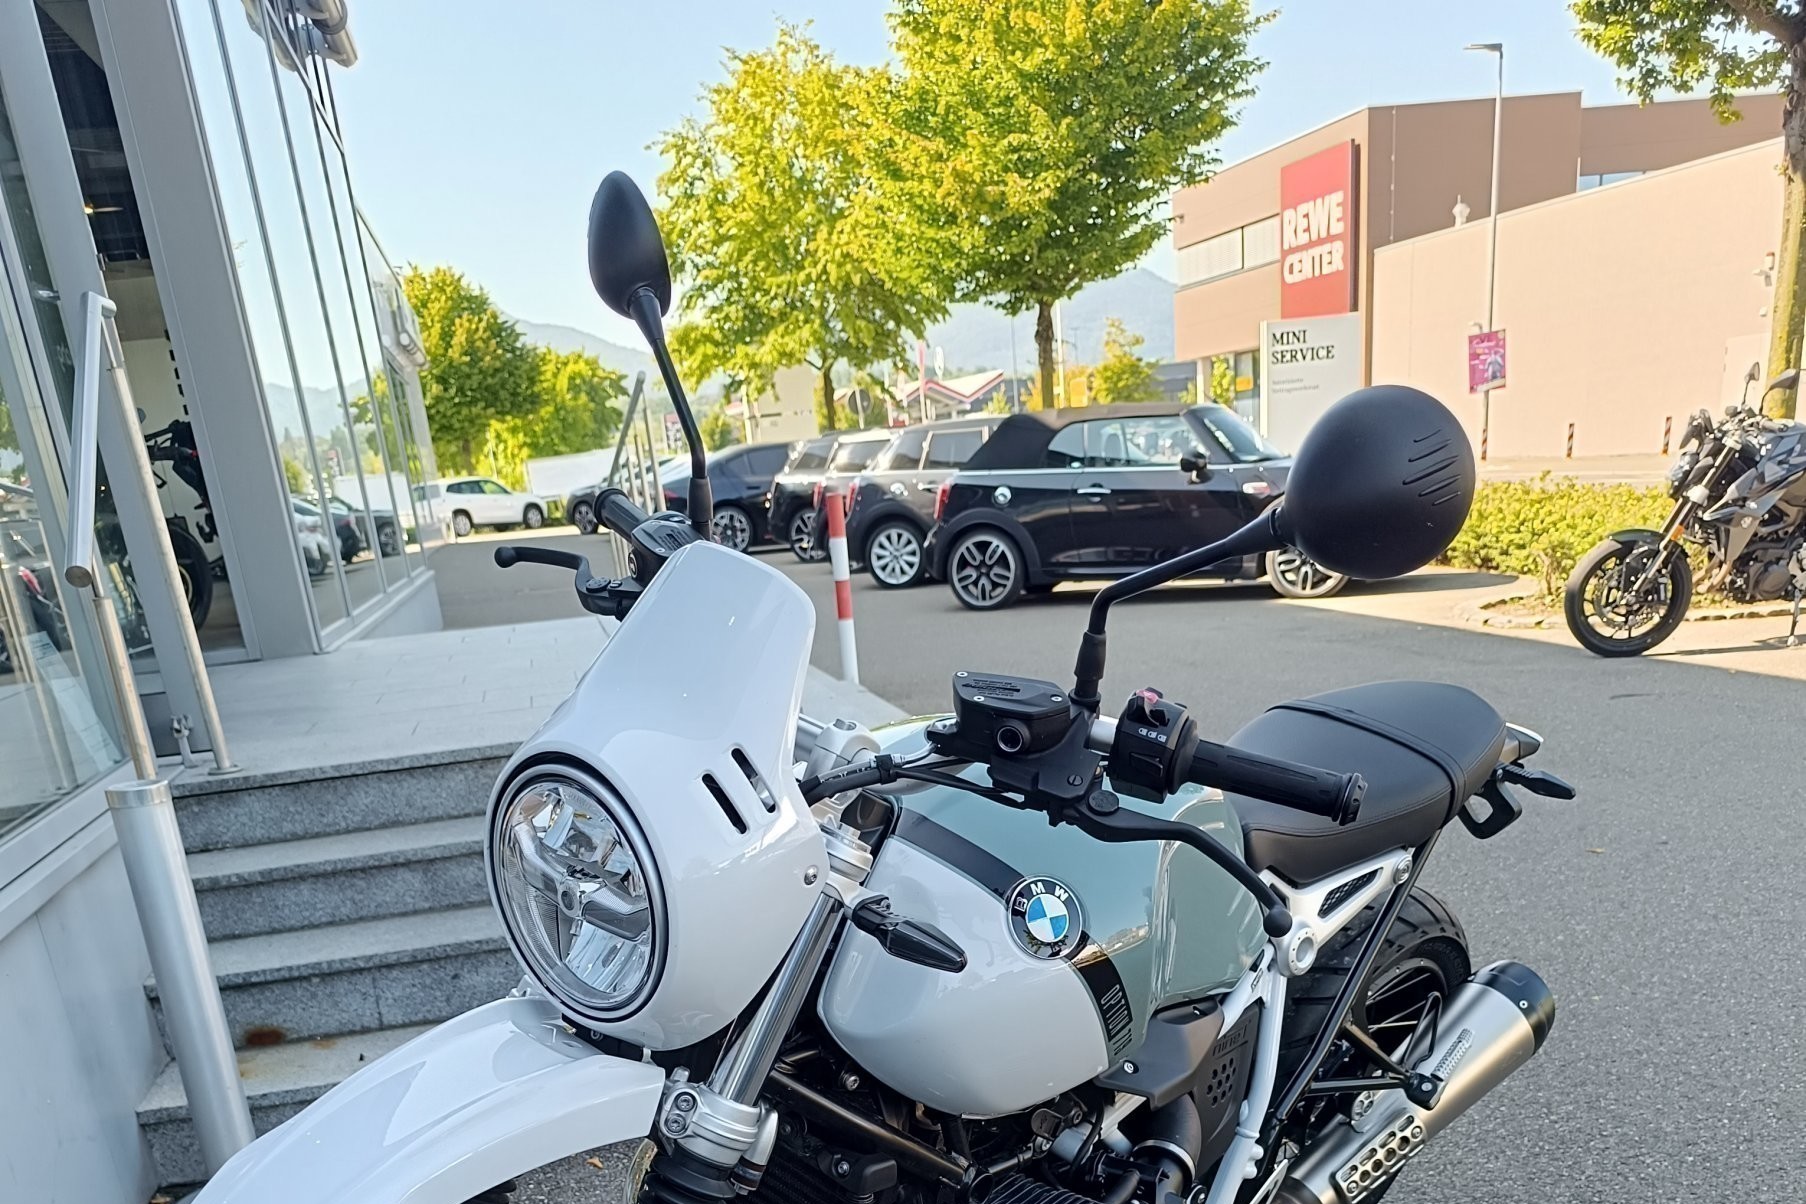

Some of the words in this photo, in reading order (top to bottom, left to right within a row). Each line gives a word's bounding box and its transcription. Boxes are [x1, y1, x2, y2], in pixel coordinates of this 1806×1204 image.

[1282, 189, 1345, 251] REWE
[1282, 240, 1345, 284] CENTER
[1271, 329, 1308, 348] MINI
[1271, 345, 1335, 365] SERVICE
[1014, 881, 1069, 912] BMW
[1100, 984, 1130, 1037] OPTION
